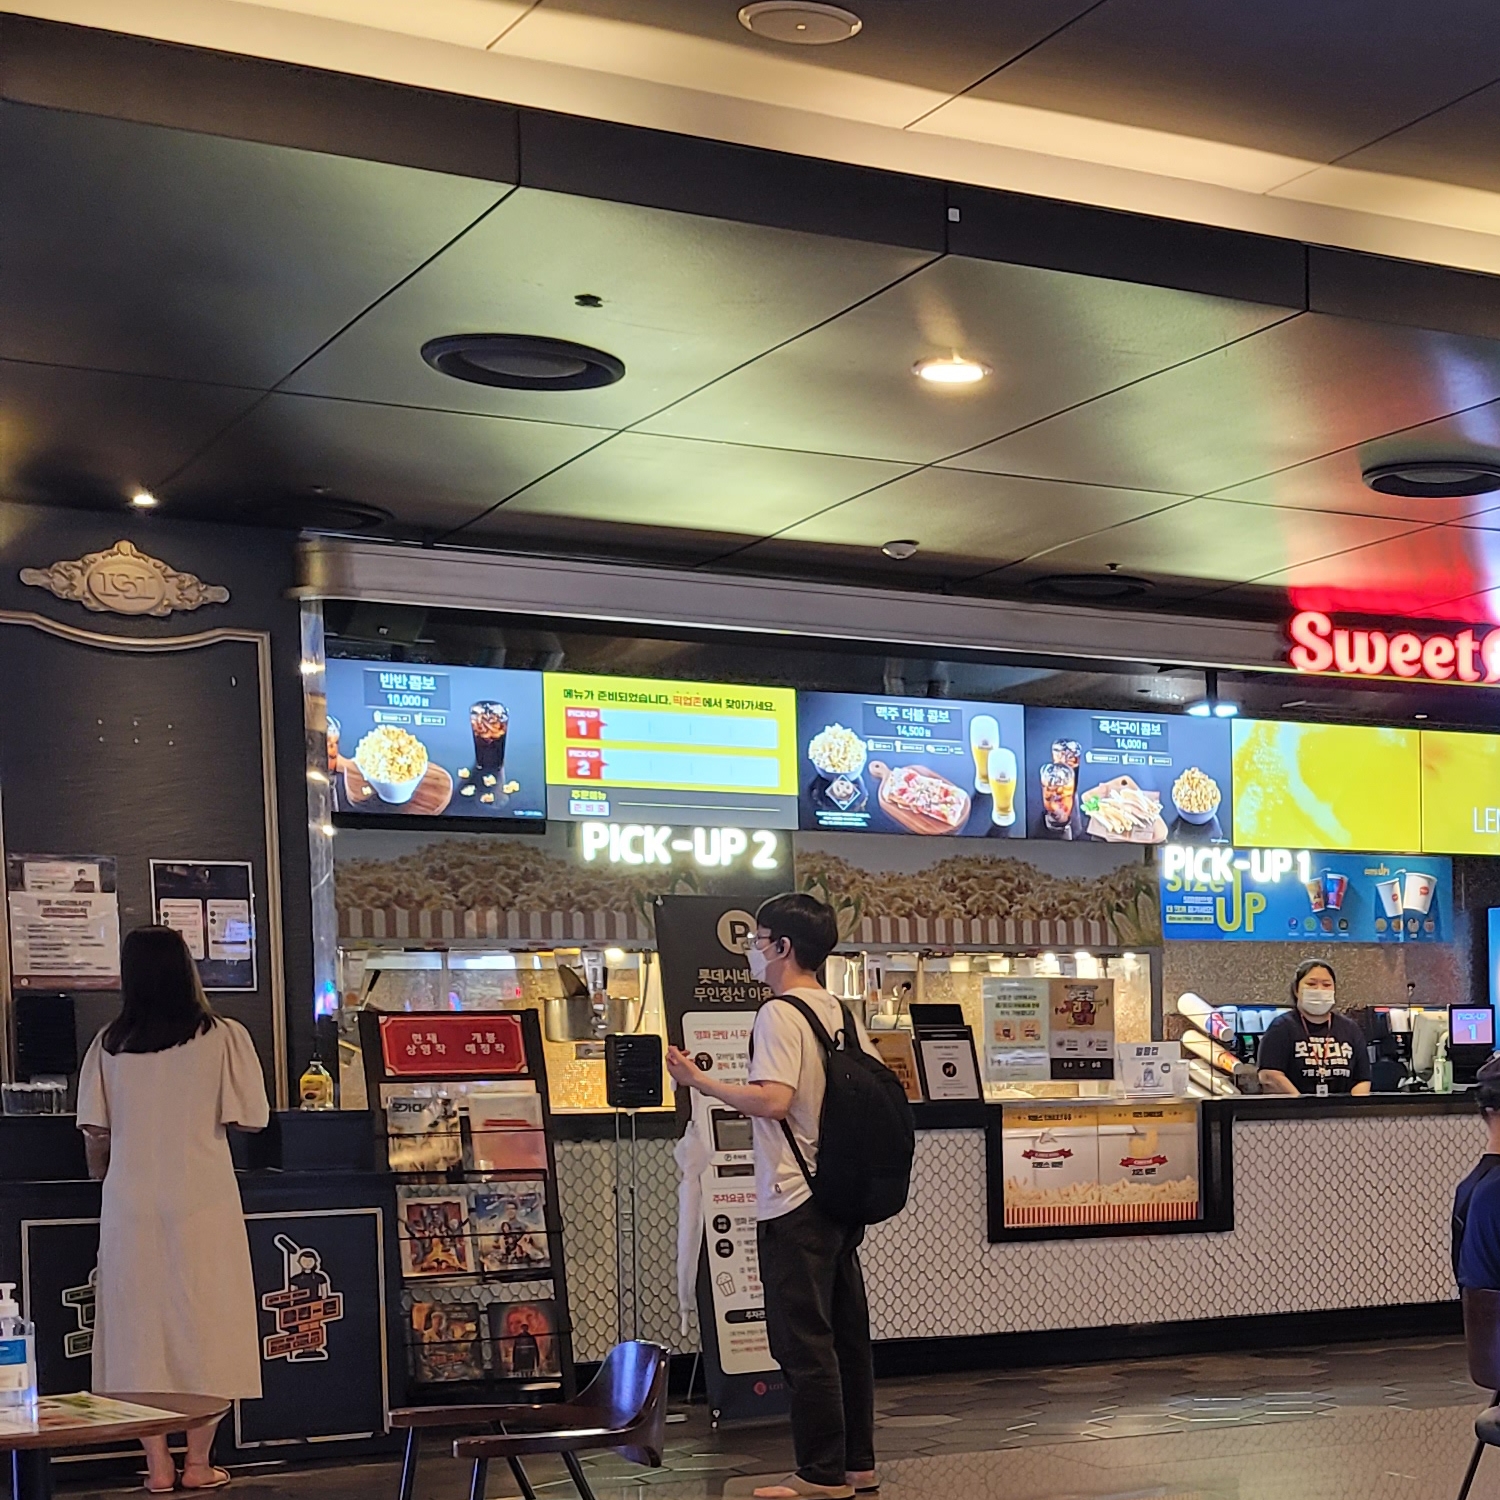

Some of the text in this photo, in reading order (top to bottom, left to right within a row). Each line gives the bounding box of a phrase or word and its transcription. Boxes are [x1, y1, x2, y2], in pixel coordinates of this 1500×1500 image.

[1289, 611, 1482, 682] Sweet
[379, 672, 436, 690] 반반 콤보
[563, 688, 777, 712] 메뉴가 준비되었습니다. 픽업존에서 찾아가세요.
[875, 706, 951, 723] 맥주 더블 콤보
[577, 720, 588, 735] 1
[1099, 720, 1162, 736] 즉석구이 콤보
[577, 760, 590, 776] 2
[581, 822, 778, 869] PICK-UP 2
[1164, 845, 1311, 884] PICK-UP 1
[698, 968, 751, 984] 롯데시네
[693, 986, 745, 1003] 무인정산
[1468, 1024, 1477, 1040] 1
[405, 1044, 446, 1056] 상영작
[465, 1043, 505, 1055] 예정작
[1295, 1041, 1353, 1059] 모가디슈
[712, 1193, 745, 1204] 주차요금
